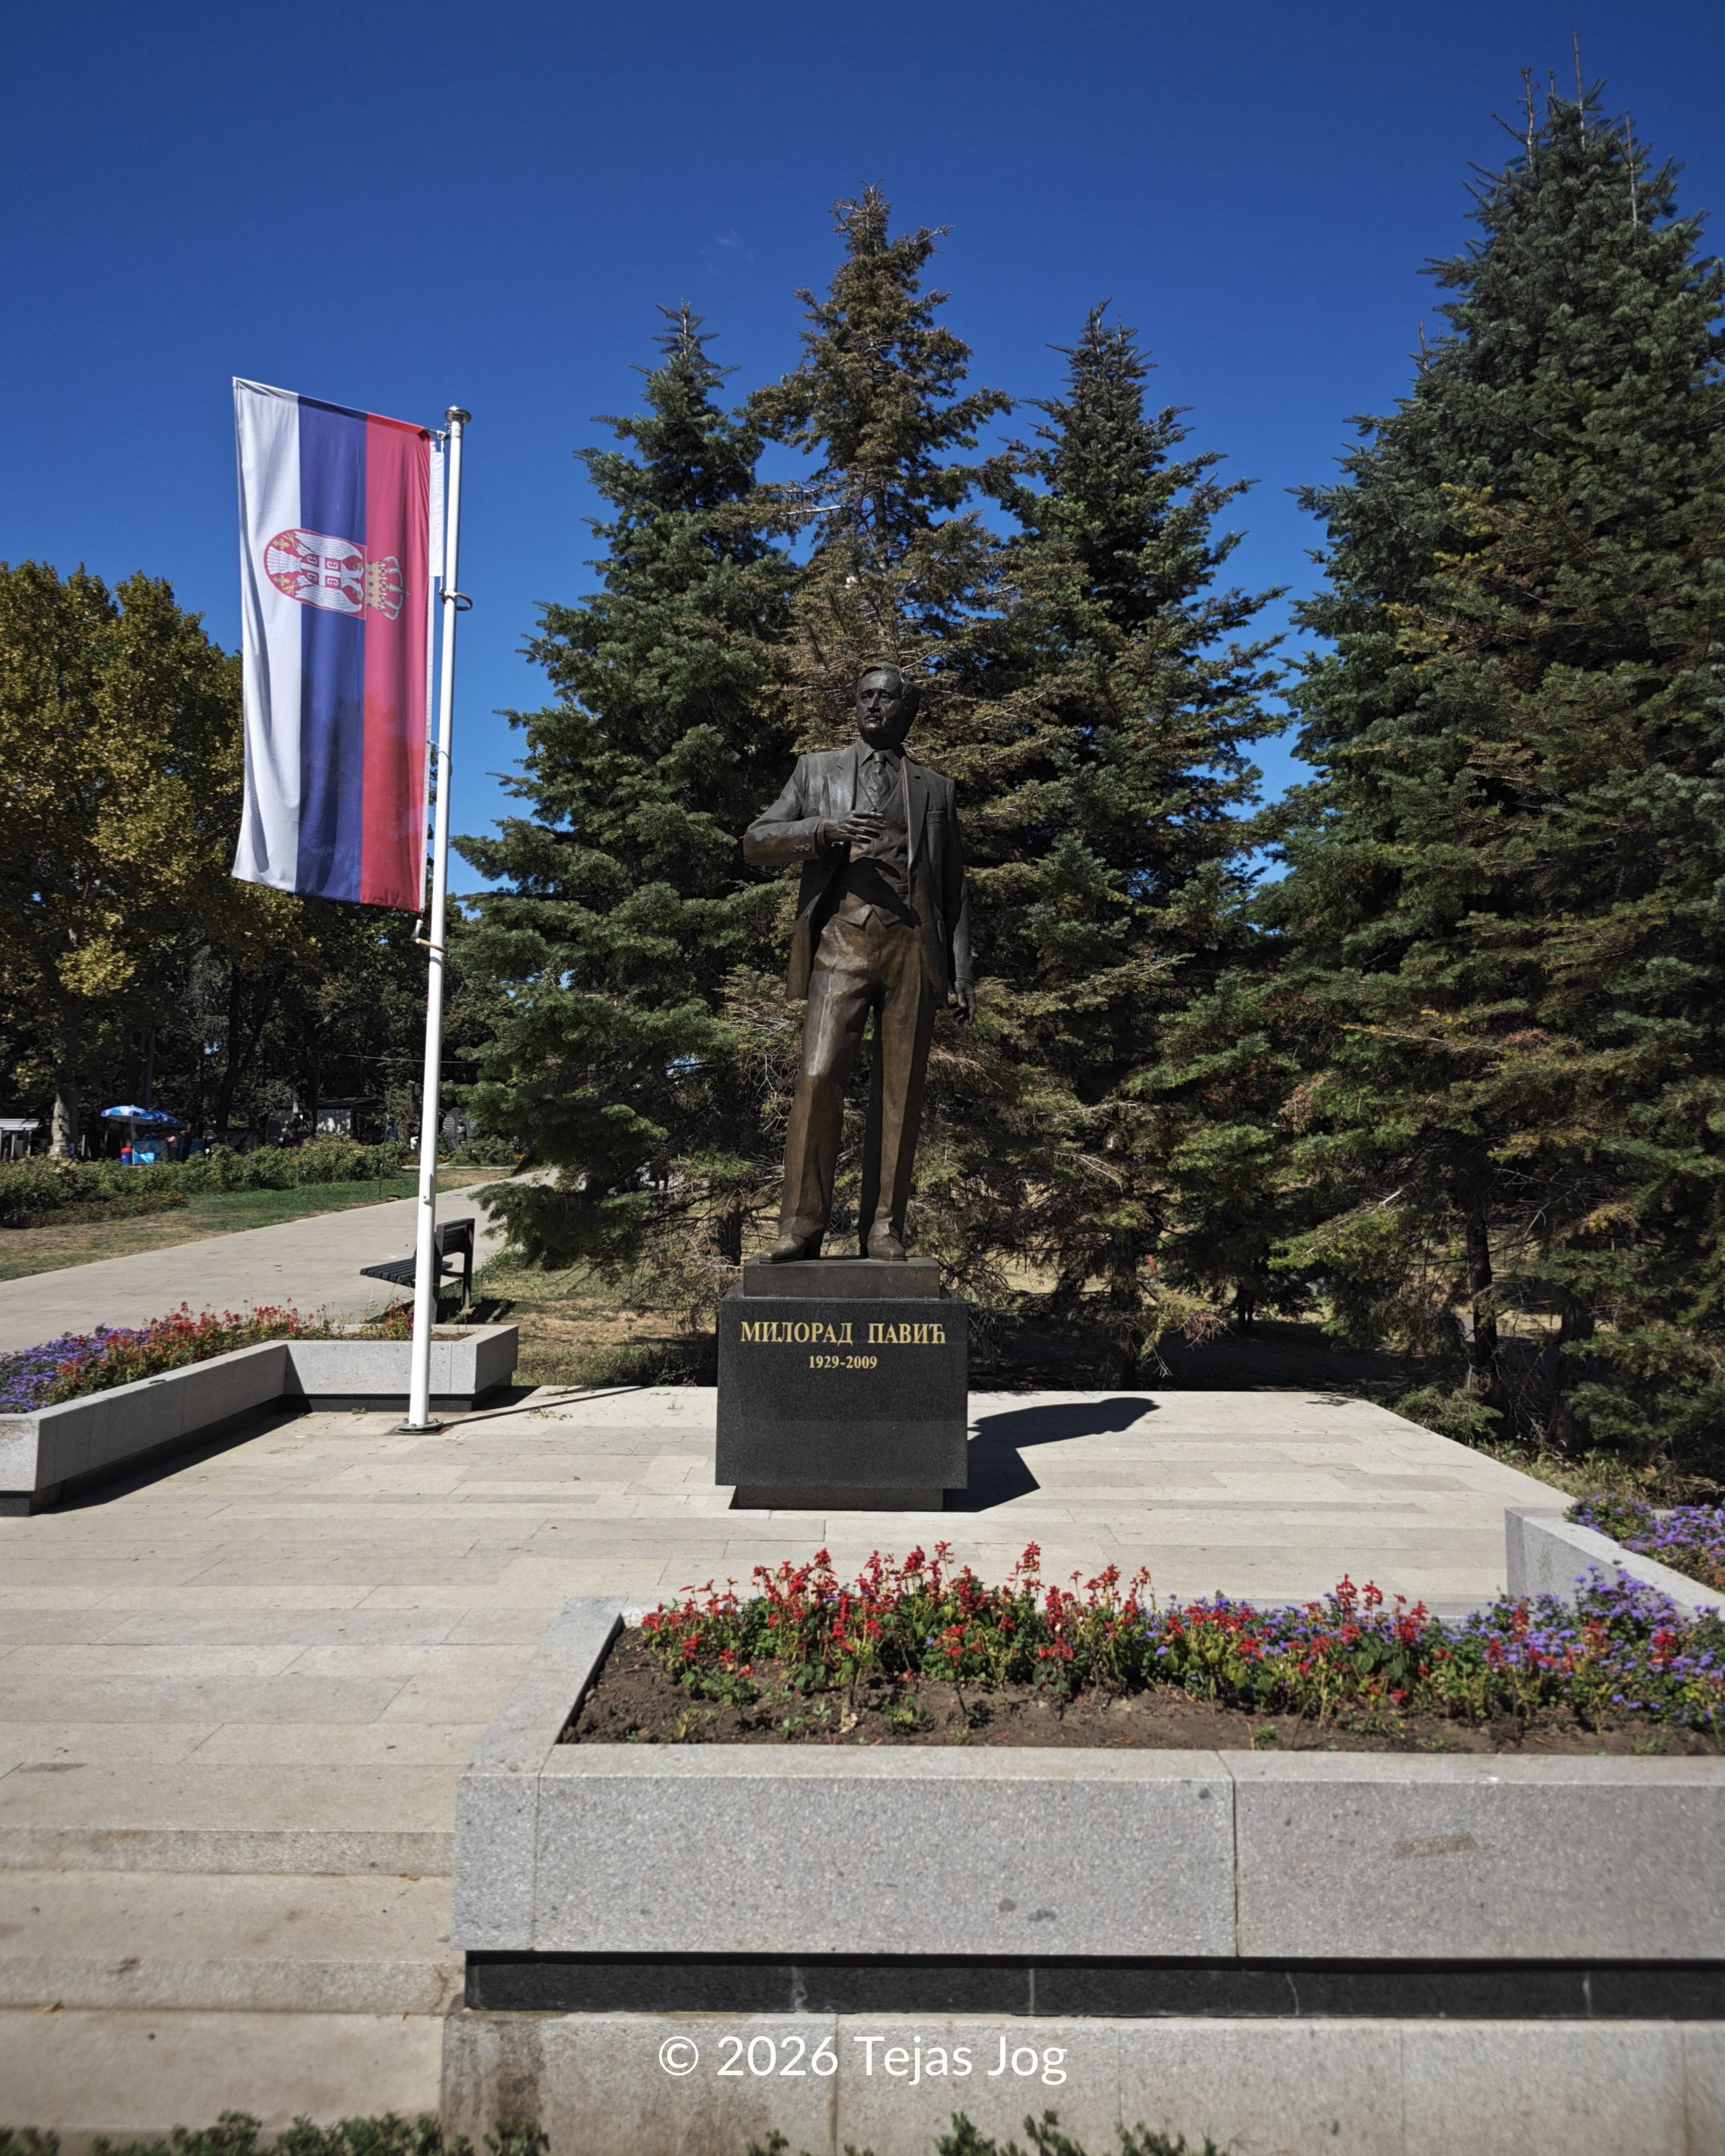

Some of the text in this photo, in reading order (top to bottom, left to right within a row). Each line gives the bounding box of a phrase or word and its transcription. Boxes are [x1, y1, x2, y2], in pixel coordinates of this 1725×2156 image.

[741, 1321, 946, 1347] МИЛОРАД ПАВИЋ
[809, 1355, 878, 1369] 1929-2009
